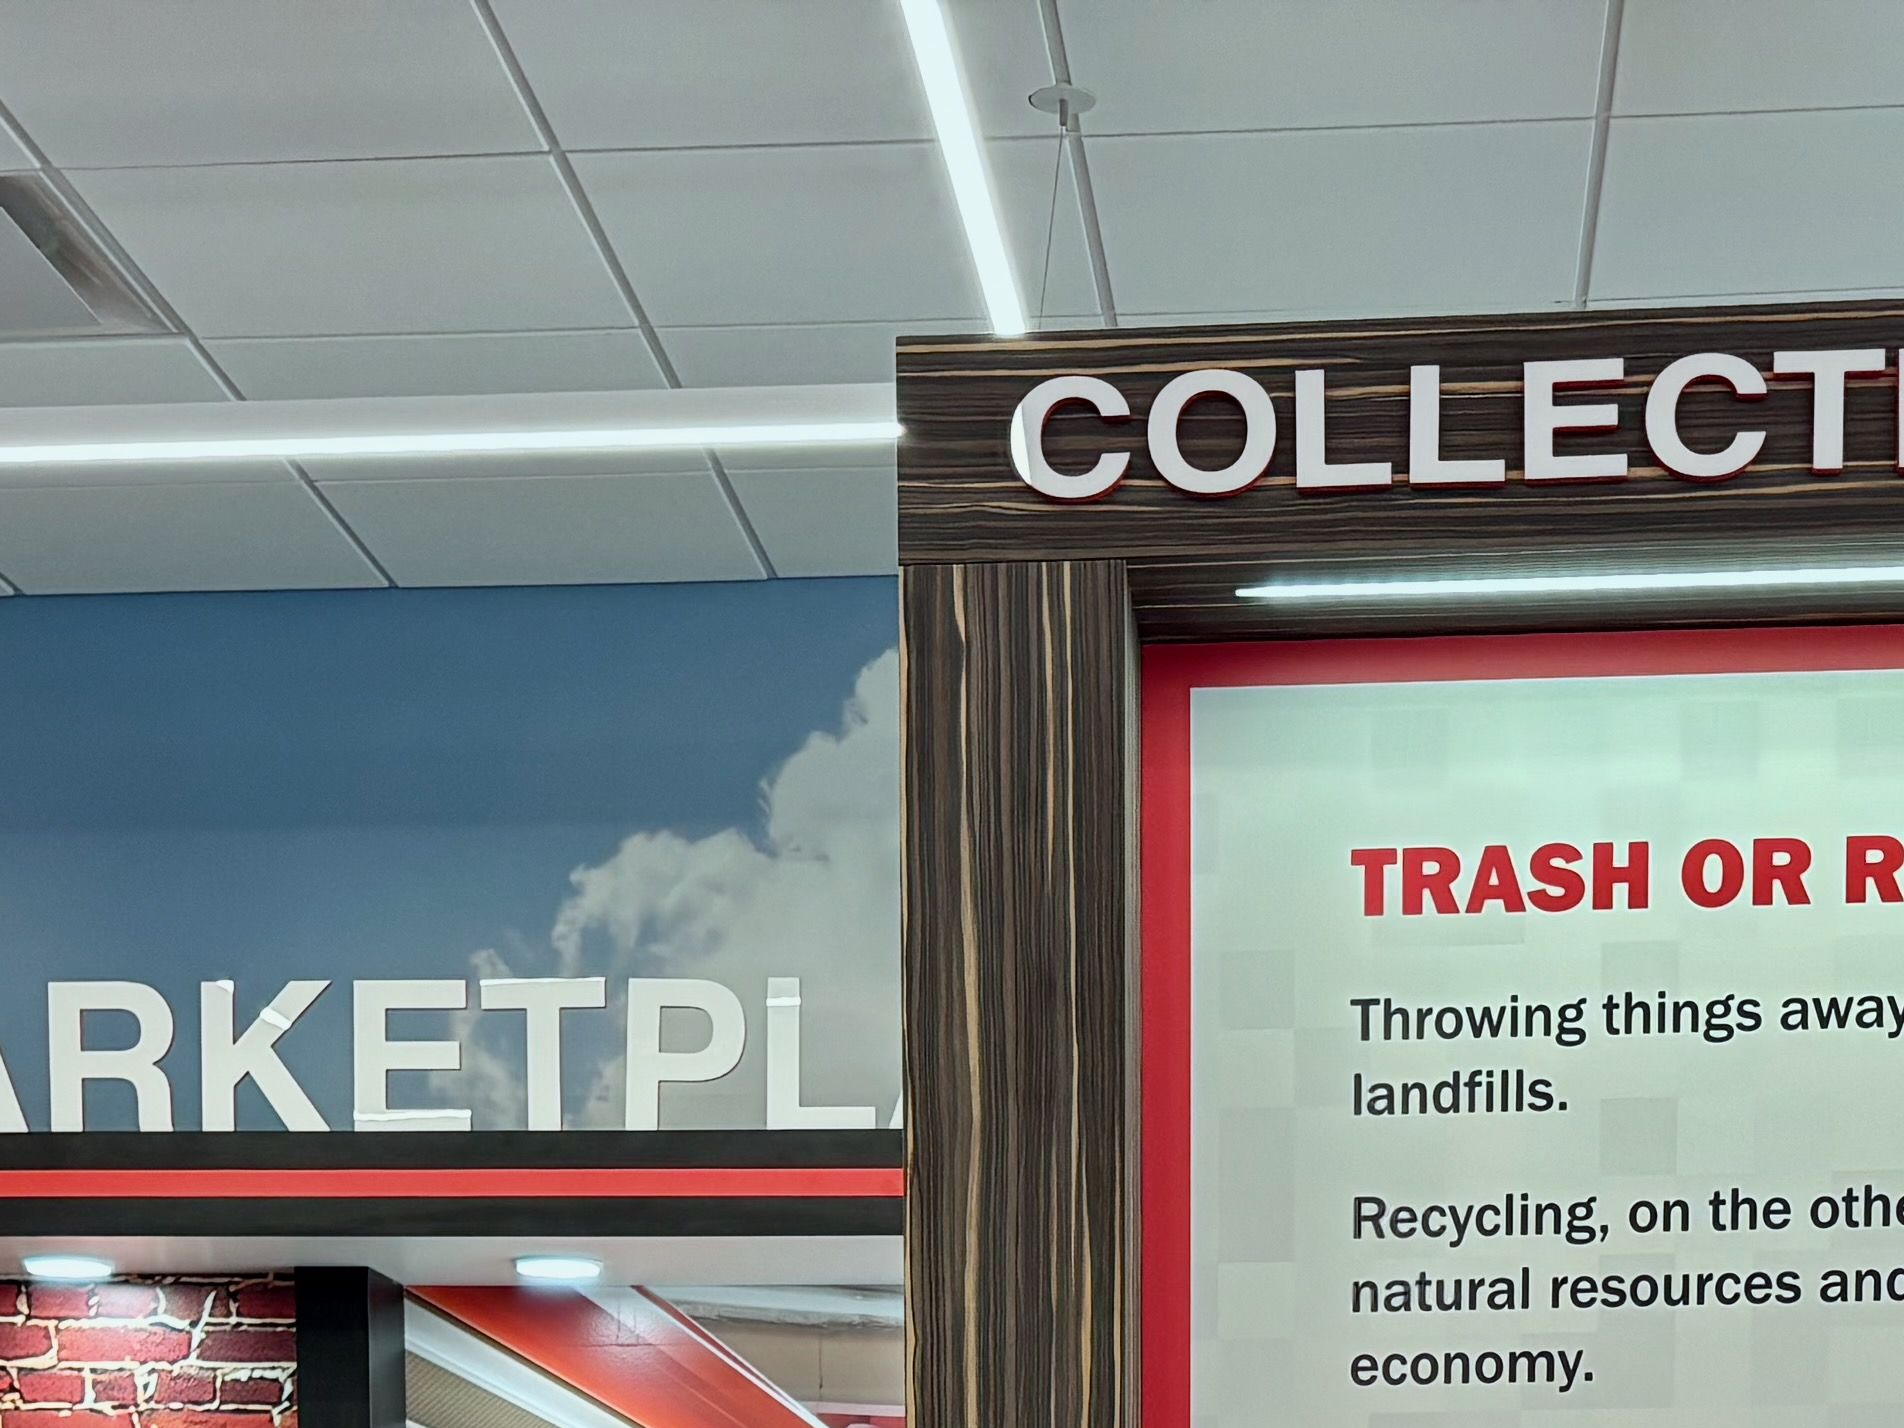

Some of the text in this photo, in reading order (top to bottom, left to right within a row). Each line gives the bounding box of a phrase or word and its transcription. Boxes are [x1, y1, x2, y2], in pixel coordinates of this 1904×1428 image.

[1350, 841, 1650, 917] TRASH
[1681, 837, 1813, 910] OR
[1348, 993, 1589, 1048] Throwing
[1600, 989, 1764, 1045] things
[1352, 1067, 1569, 1117] landfills.
[1352, 1191, 1610, 1249] Recycling,
[1627, 1198, 1691, 1235] on
[1707, 1186, 1793, 1233] the
[1351, 1265, 1531, 1314] natural
[1550, 1269, 1803, 1310] resources
[1349, 1348, 1595, 1394] economy.
